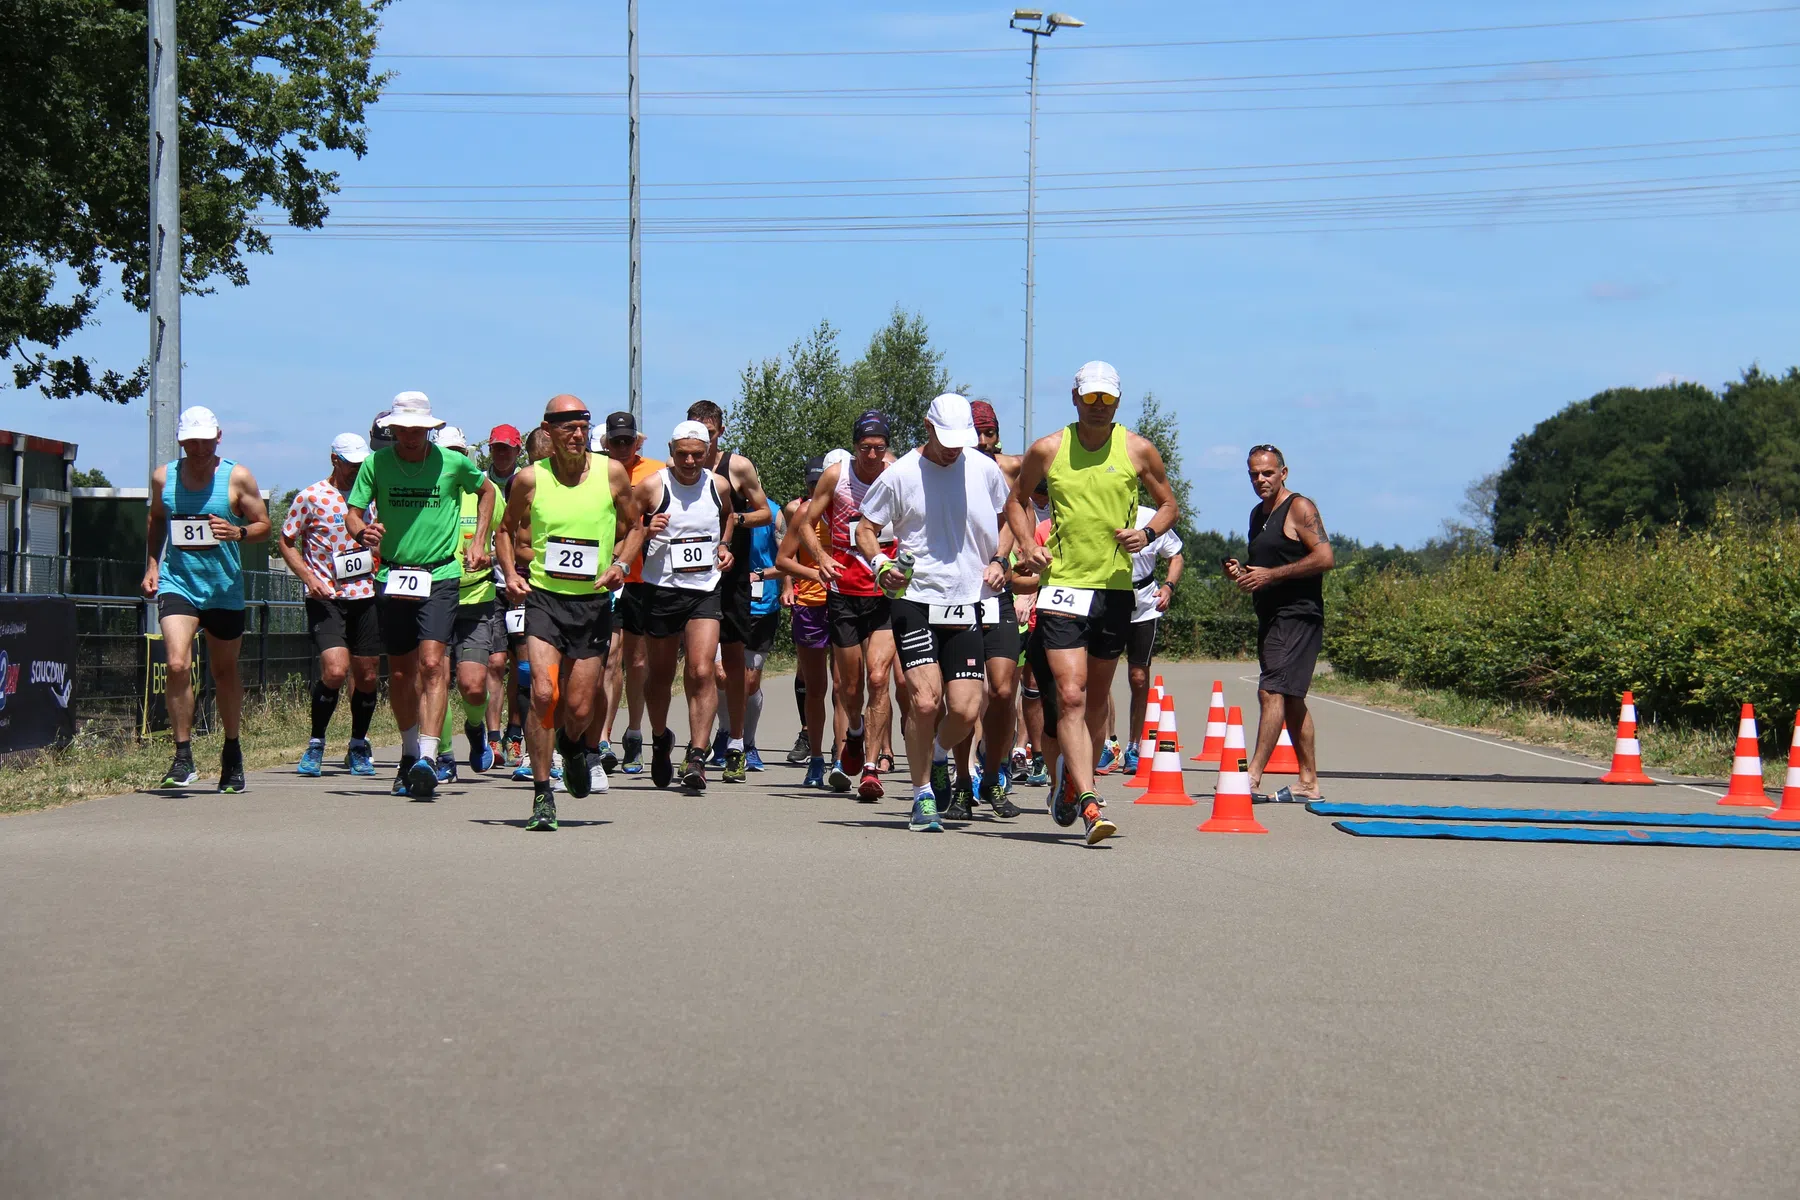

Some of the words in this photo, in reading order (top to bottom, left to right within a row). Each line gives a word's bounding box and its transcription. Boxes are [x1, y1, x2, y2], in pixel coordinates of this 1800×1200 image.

[184, 525, 204, 540] 81
[559, 550, 584, 568] 28
[683, 547, 702, 562] 80
[345, 557, 362, 572] 60
[398, 575, 418, 591] 70
[1051, 589, 1075, 607] 54
[944, 605, 964, 618] 74
[514, 614, 523, 628] 7
